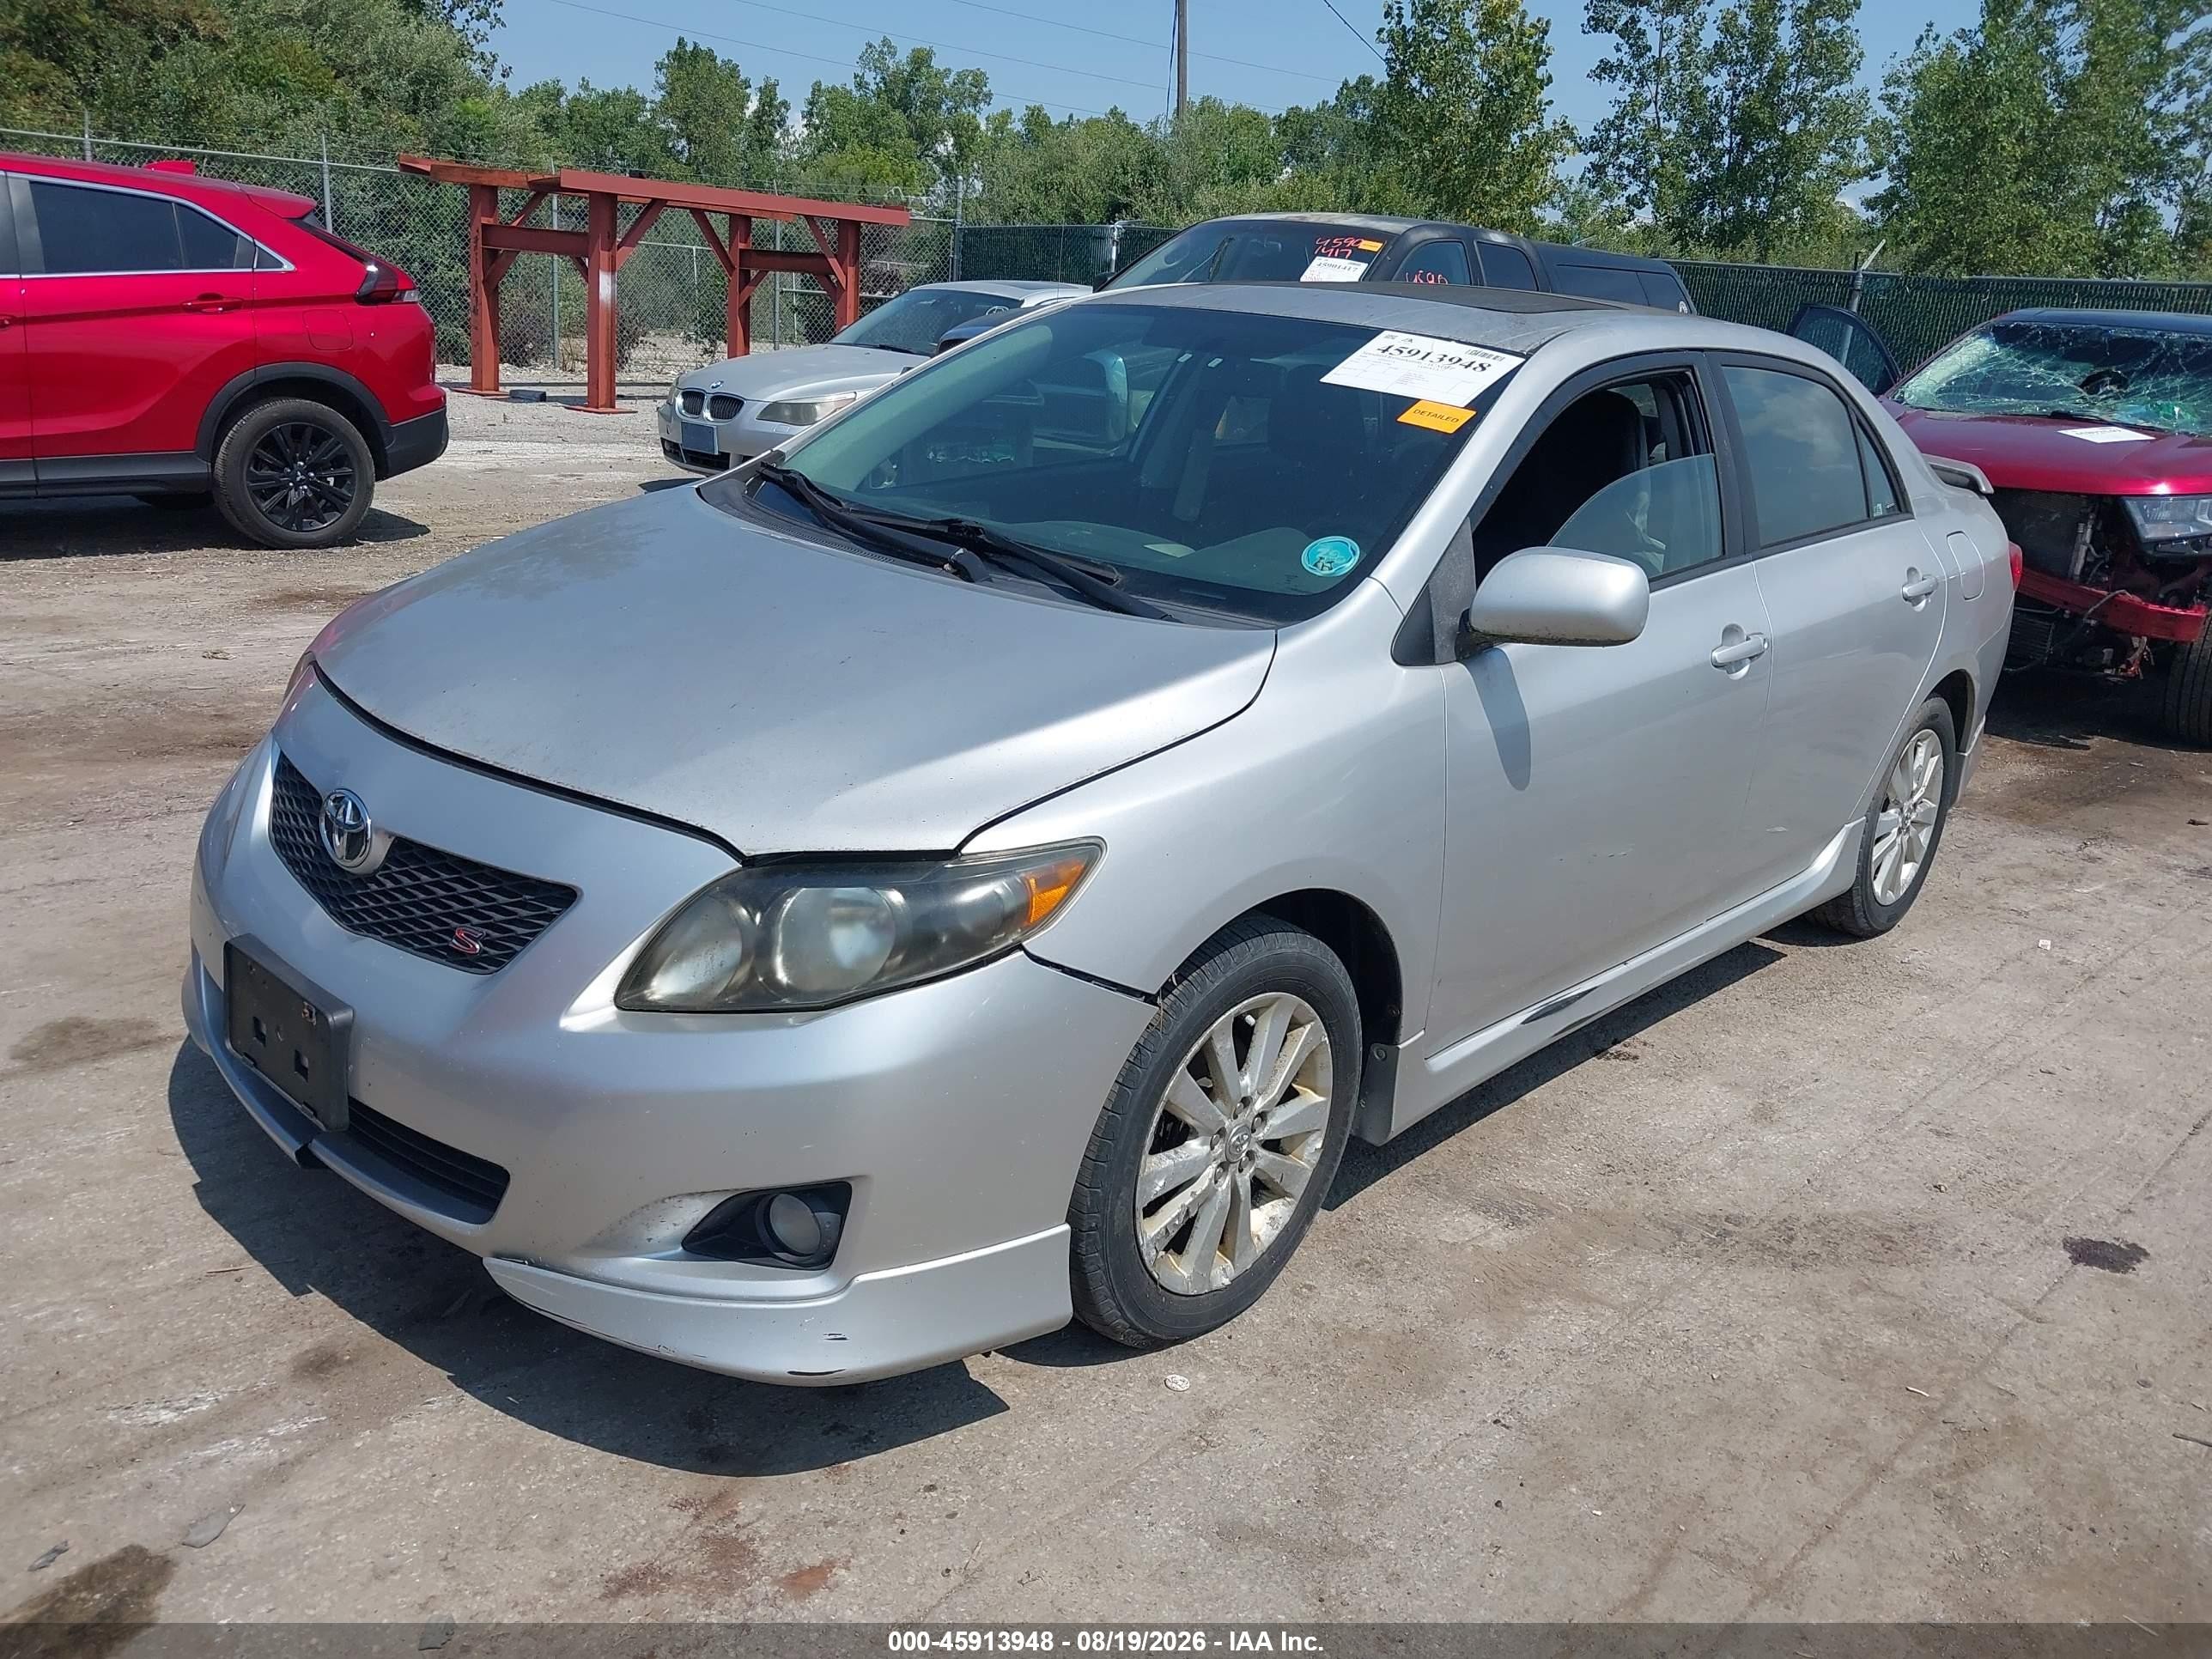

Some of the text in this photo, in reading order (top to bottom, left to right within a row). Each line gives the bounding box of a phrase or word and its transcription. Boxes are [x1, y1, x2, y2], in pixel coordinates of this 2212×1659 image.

[1314, 246, 1352, 260] 1417
[1376, 344, 1492, 373] 45913948
[1413, 409, 1460, 423] DETAILED
